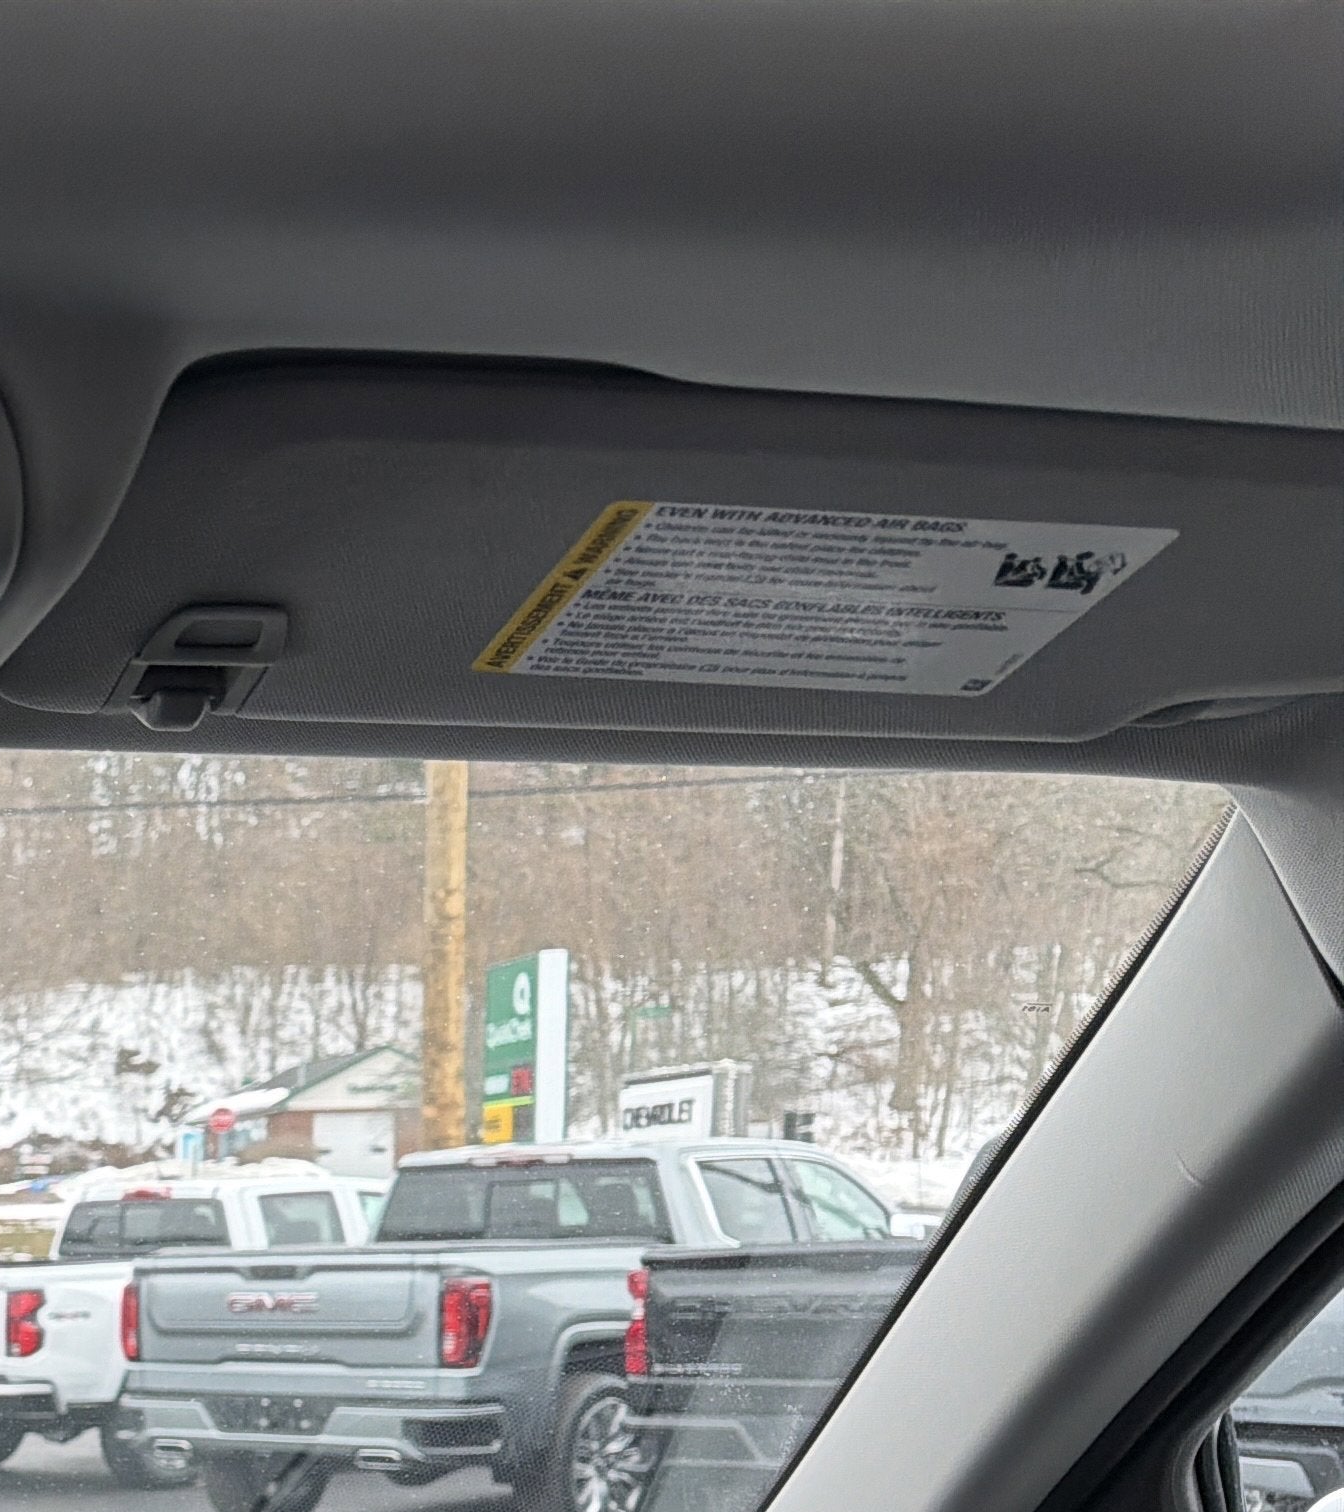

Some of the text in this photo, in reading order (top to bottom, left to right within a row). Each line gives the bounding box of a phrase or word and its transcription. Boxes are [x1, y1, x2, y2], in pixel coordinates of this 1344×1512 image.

[655, 506, 968, 533] EVEN WITH ADVANCED AIR BAGS
[635, 591, 685, 605] AVEC
[885, 606, 1007, 622] INTELLIGENTS
